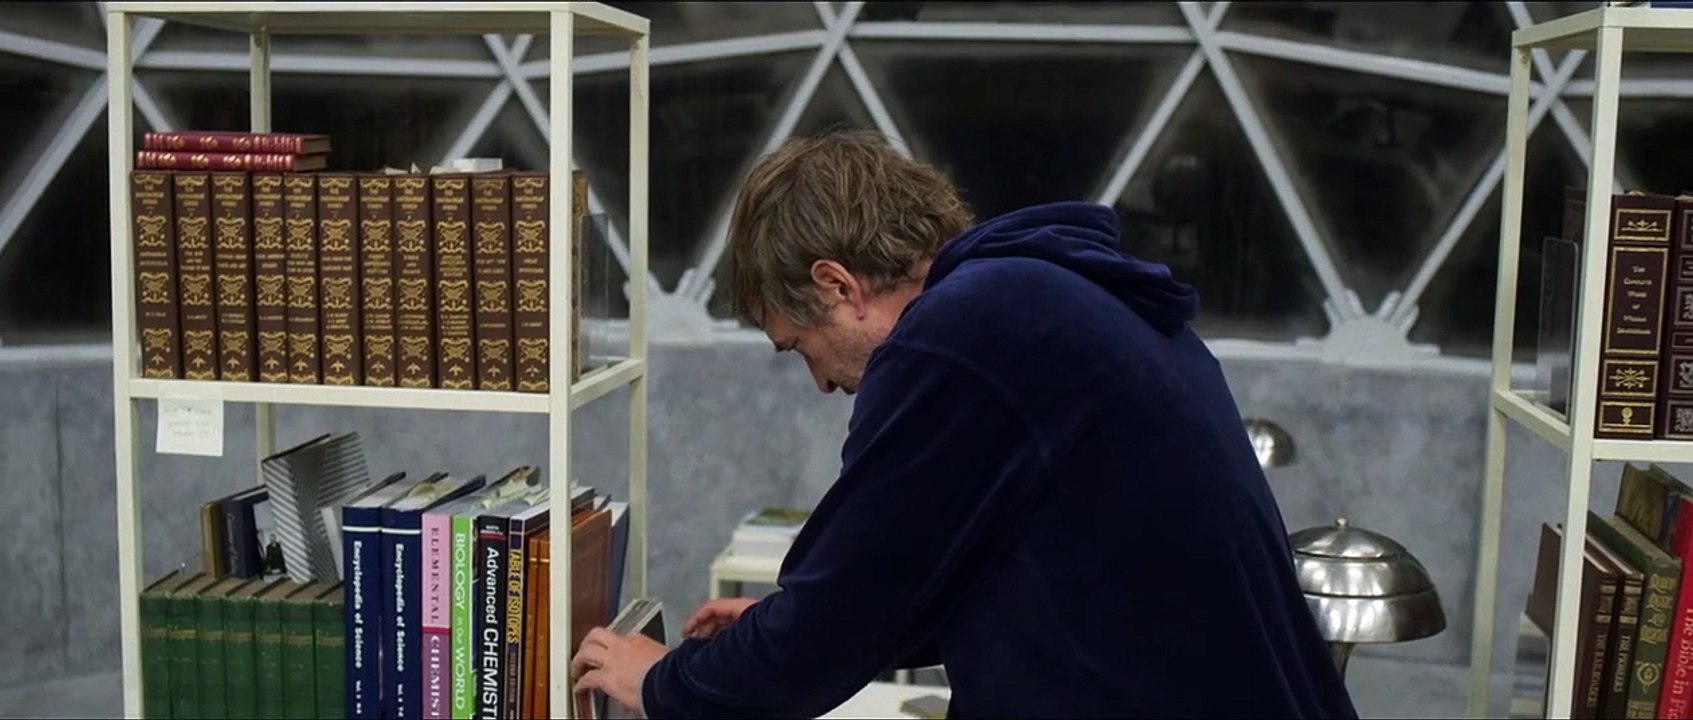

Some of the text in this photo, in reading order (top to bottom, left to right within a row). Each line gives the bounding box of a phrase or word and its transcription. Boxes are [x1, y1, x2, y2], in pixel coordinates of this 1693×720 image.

[352, 540, 362, 610] Encyclopedia
[394, 544, 405, 613] Encyclopedia
[455, 533, 466, 610] BIOLOGY
[509, 547, 522, 578] TABLE
[485, 547, 499, 624] Advanced
[509, 580, 521, 592] OF
[354, 613, 363, 624] of
[396, 616, 405, 627] of
[430, 527, 440, 718] ELEMENTAL CHEMIST
[507, 595, 520, 644] ISOTOPES
[354, 627, 363, 668] Science
[396, 630, 405, 672] Science
[1676, 639, 1693, 677] Bible
[455, 646, 466, 709] WORLD
[1673, 680, 1689, 695] in
